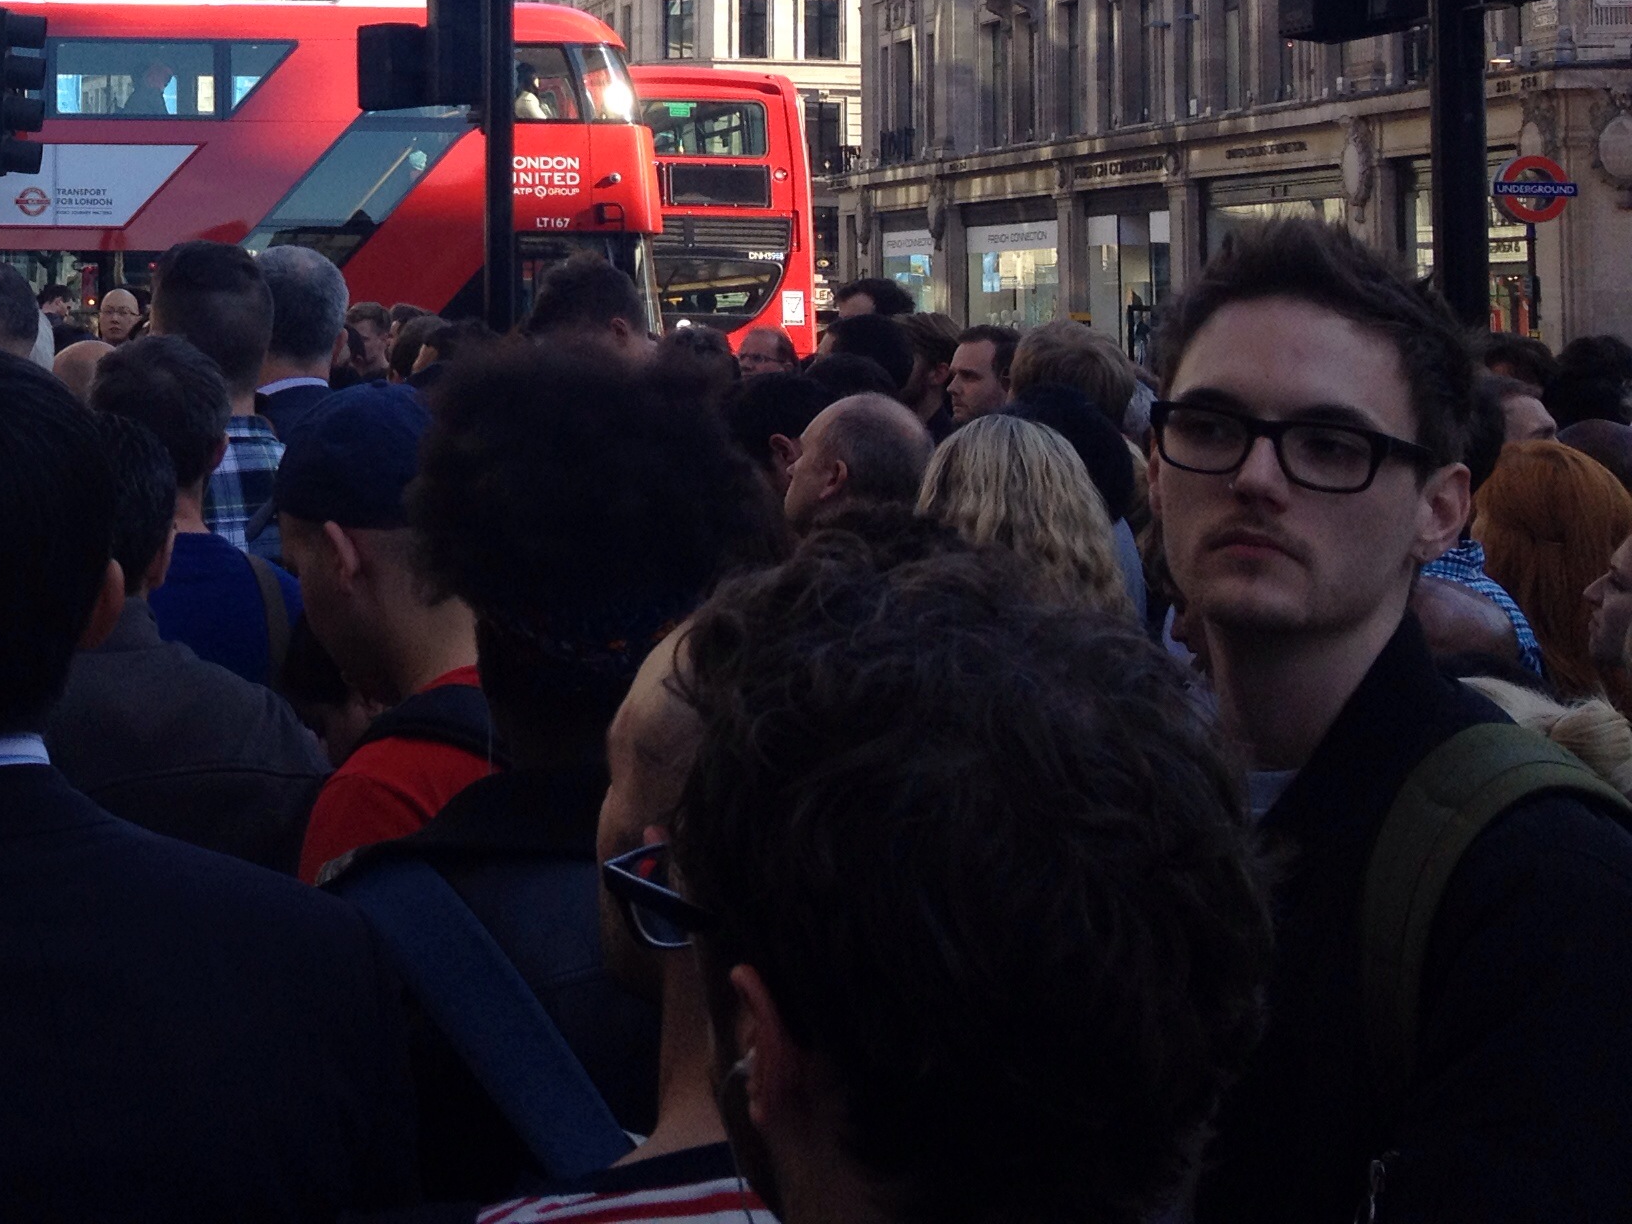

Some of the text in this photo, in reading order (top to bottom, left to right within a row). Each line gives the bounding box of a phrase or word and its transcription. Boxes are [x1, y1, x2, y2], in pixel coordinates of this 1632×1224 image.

[513, 156, 580, 170] ONDON
[513, 171, 581, 185] NITED
[56, 188, 107, 196] TRANSPORT
[513, 187, 533, 195] ATP
[1496, 183, 1575, 195] UNDERGROUND
[55, 197, 113, 206] FOR LONDON
[536, 217, 570, 228] LT167
